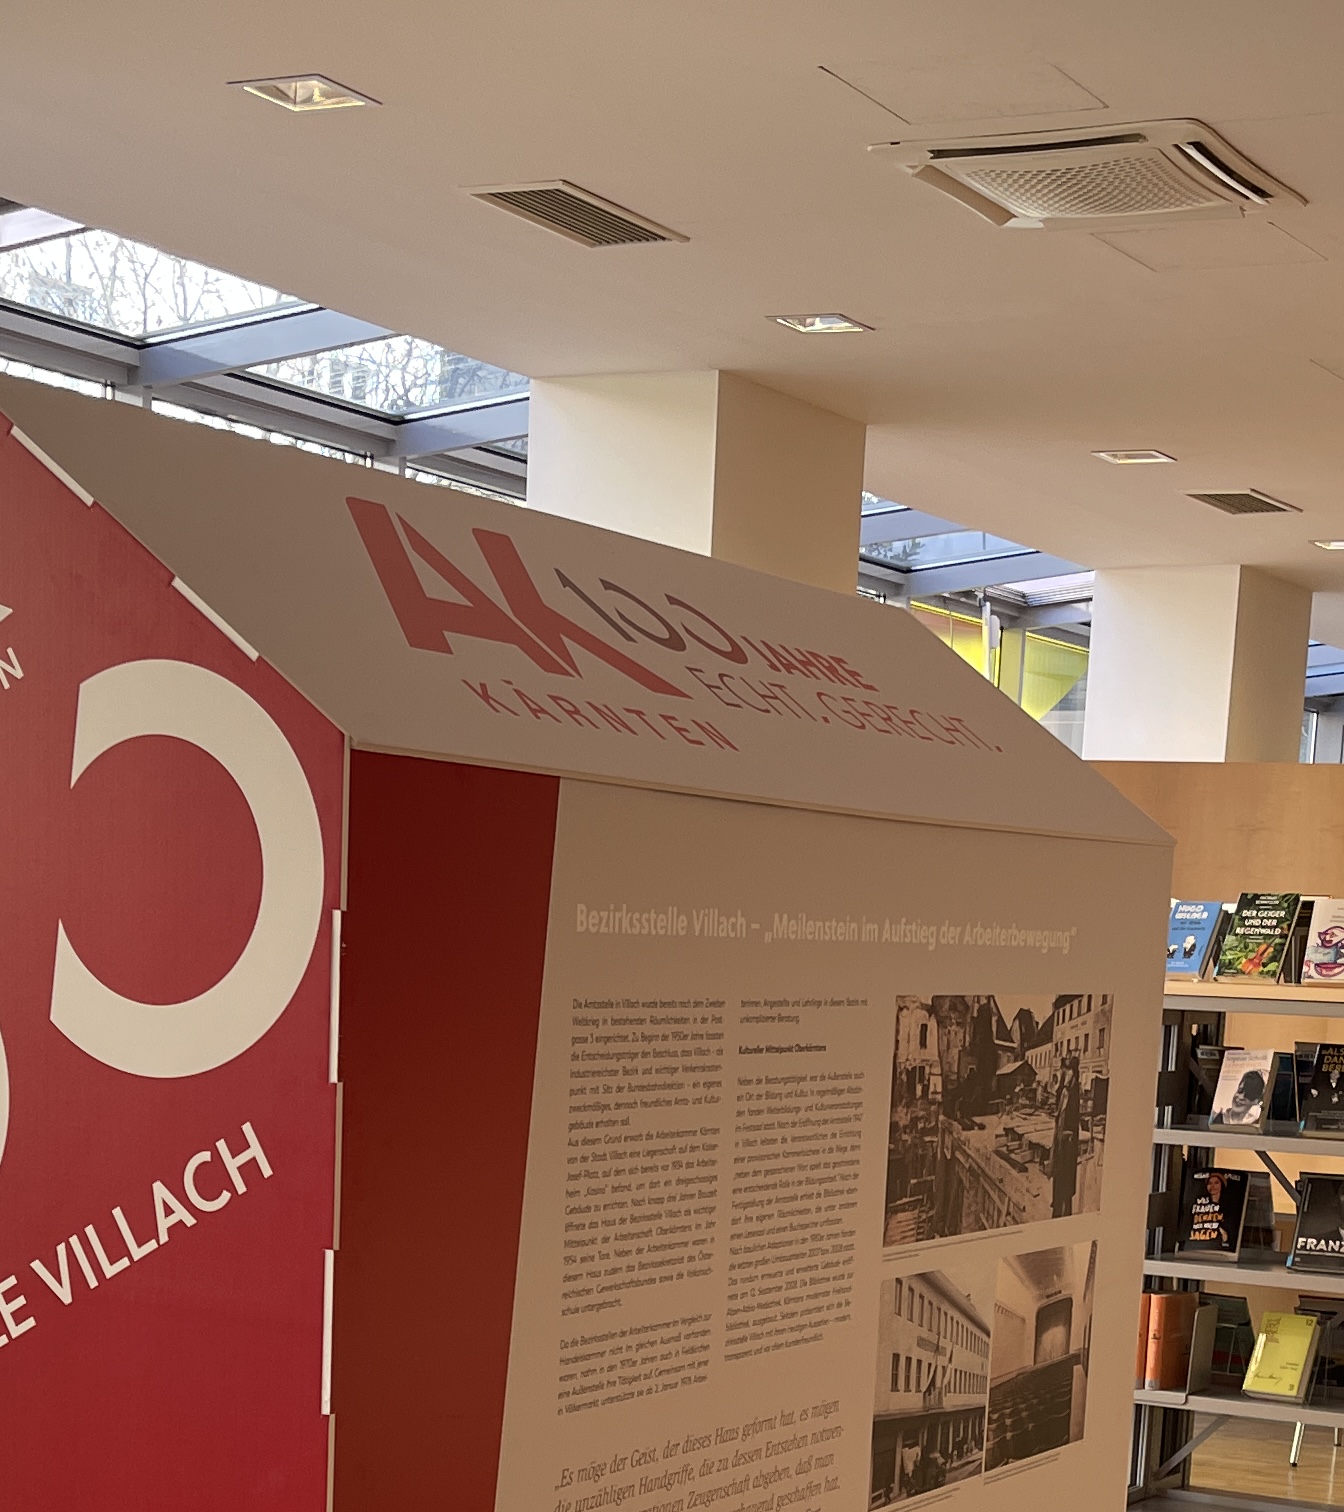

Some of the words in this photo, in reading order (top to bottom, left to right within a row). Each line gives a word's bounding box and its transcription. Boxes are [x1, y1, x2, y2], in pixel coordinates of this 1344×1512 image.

[345, 496, 692, 699] AK
[553, 567, 748, 665] 100
[740, 633, 881, 692] JAHRE
[462, 679, 740, 752] KÄRNTEN
[576, 903, 688, 937] Bezirksstelle
[692, 908, 747, 939] Villach
[861, 915, 878, 943] im
[882, 917, 936, 952] Aufstieg
[940, 919, 959, 946] der
[30, 1122, 274, 1305] VILLACH
[575, 1482, 636, 1512] unzähligen
[698, 1458, 714, 1479] die
[716, 1455, 729, 1472] zu
[732, 1445, 762, 1469] dessen
[578, 1461, 606, 1483] möge
[610, 1456, 628, 1475] der
[663, 1441, 680, 1461] der
[682, 1433, 712, 1455] dieses
[715, 1426, 739, 1446] Haus
